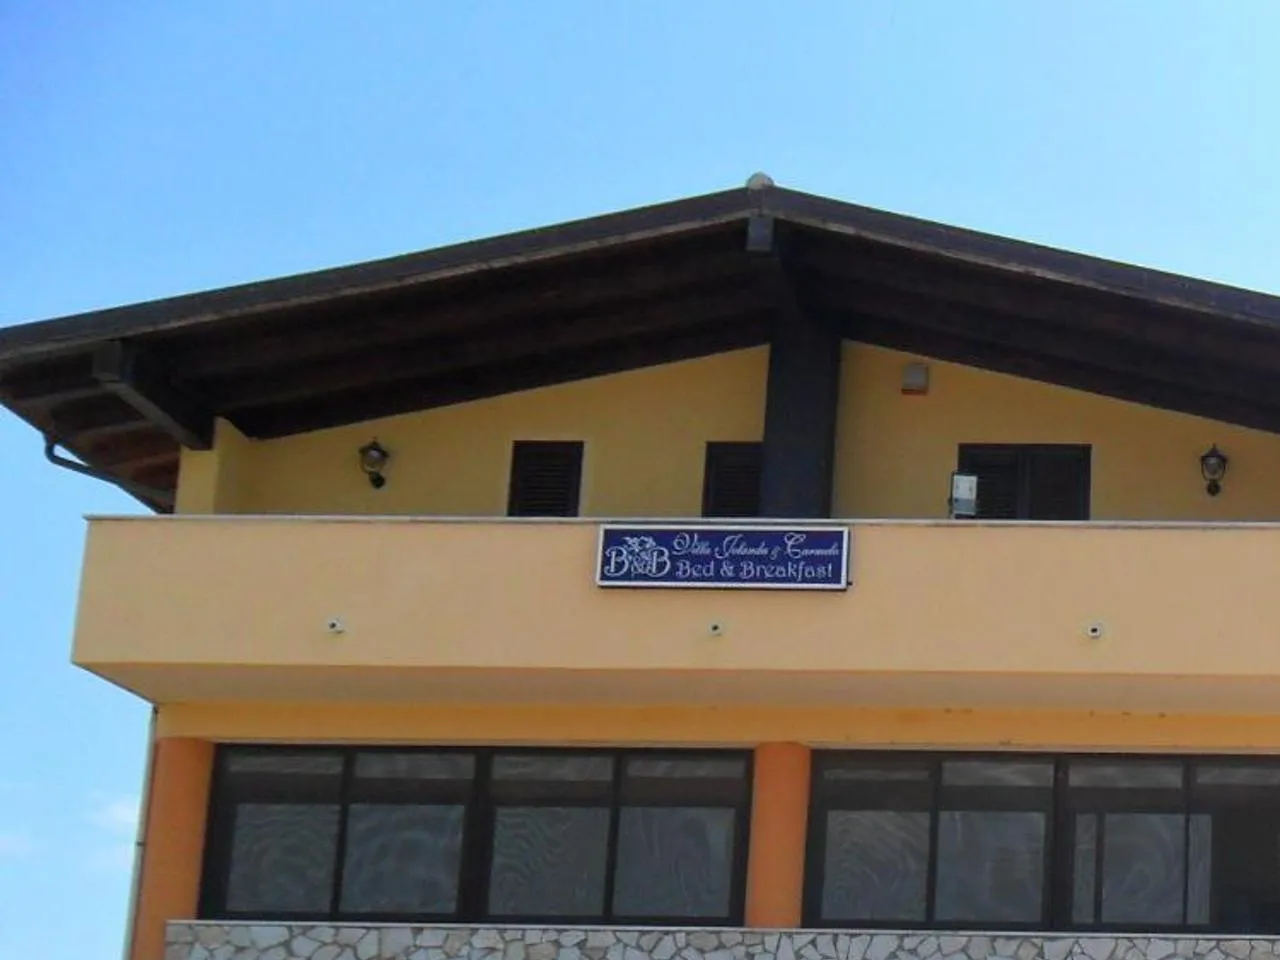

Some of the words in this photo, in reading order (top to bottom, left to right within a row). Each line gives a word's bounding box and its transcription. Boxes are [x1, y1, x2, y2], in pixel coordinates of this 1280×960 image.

[676, 560, 715, 578] Bed
[720, 561, 735, 577] &
[740, 561, 832, 582] Breakfast
